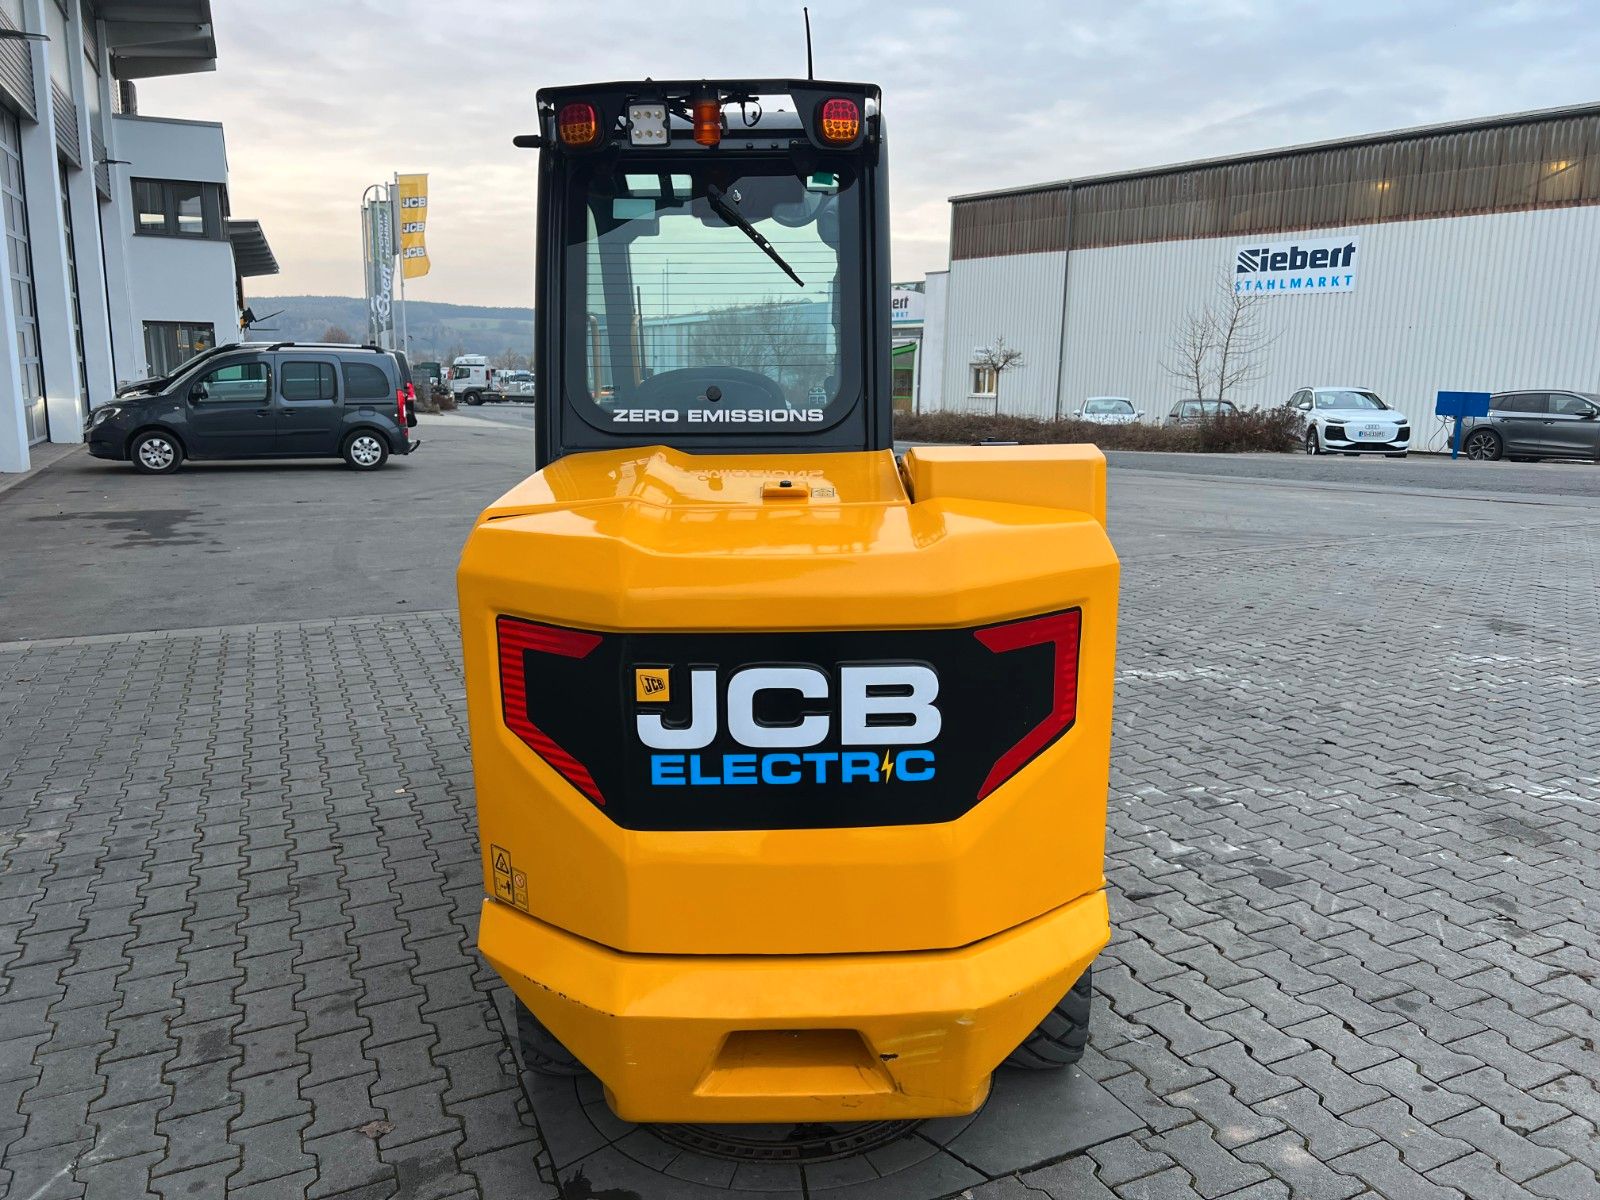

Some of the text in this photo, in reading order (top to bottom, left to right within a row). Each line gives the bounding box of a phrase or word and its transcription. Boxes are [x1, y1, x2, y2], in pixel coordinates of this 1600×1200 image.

[402, 197, 426, 208] JCB
[402, 222, 425, 233] JCB
[403, 247, 425, 258] JCB
[1236, 242, 1356, 273] Siebert
[1235, 275, 1353, 291] STAHLMARKT
[613, 408, 824, 423] ZERO EMISSIONS
[644, 677, 664, 693] JCB
[636, 667, 942, 749] JCB
